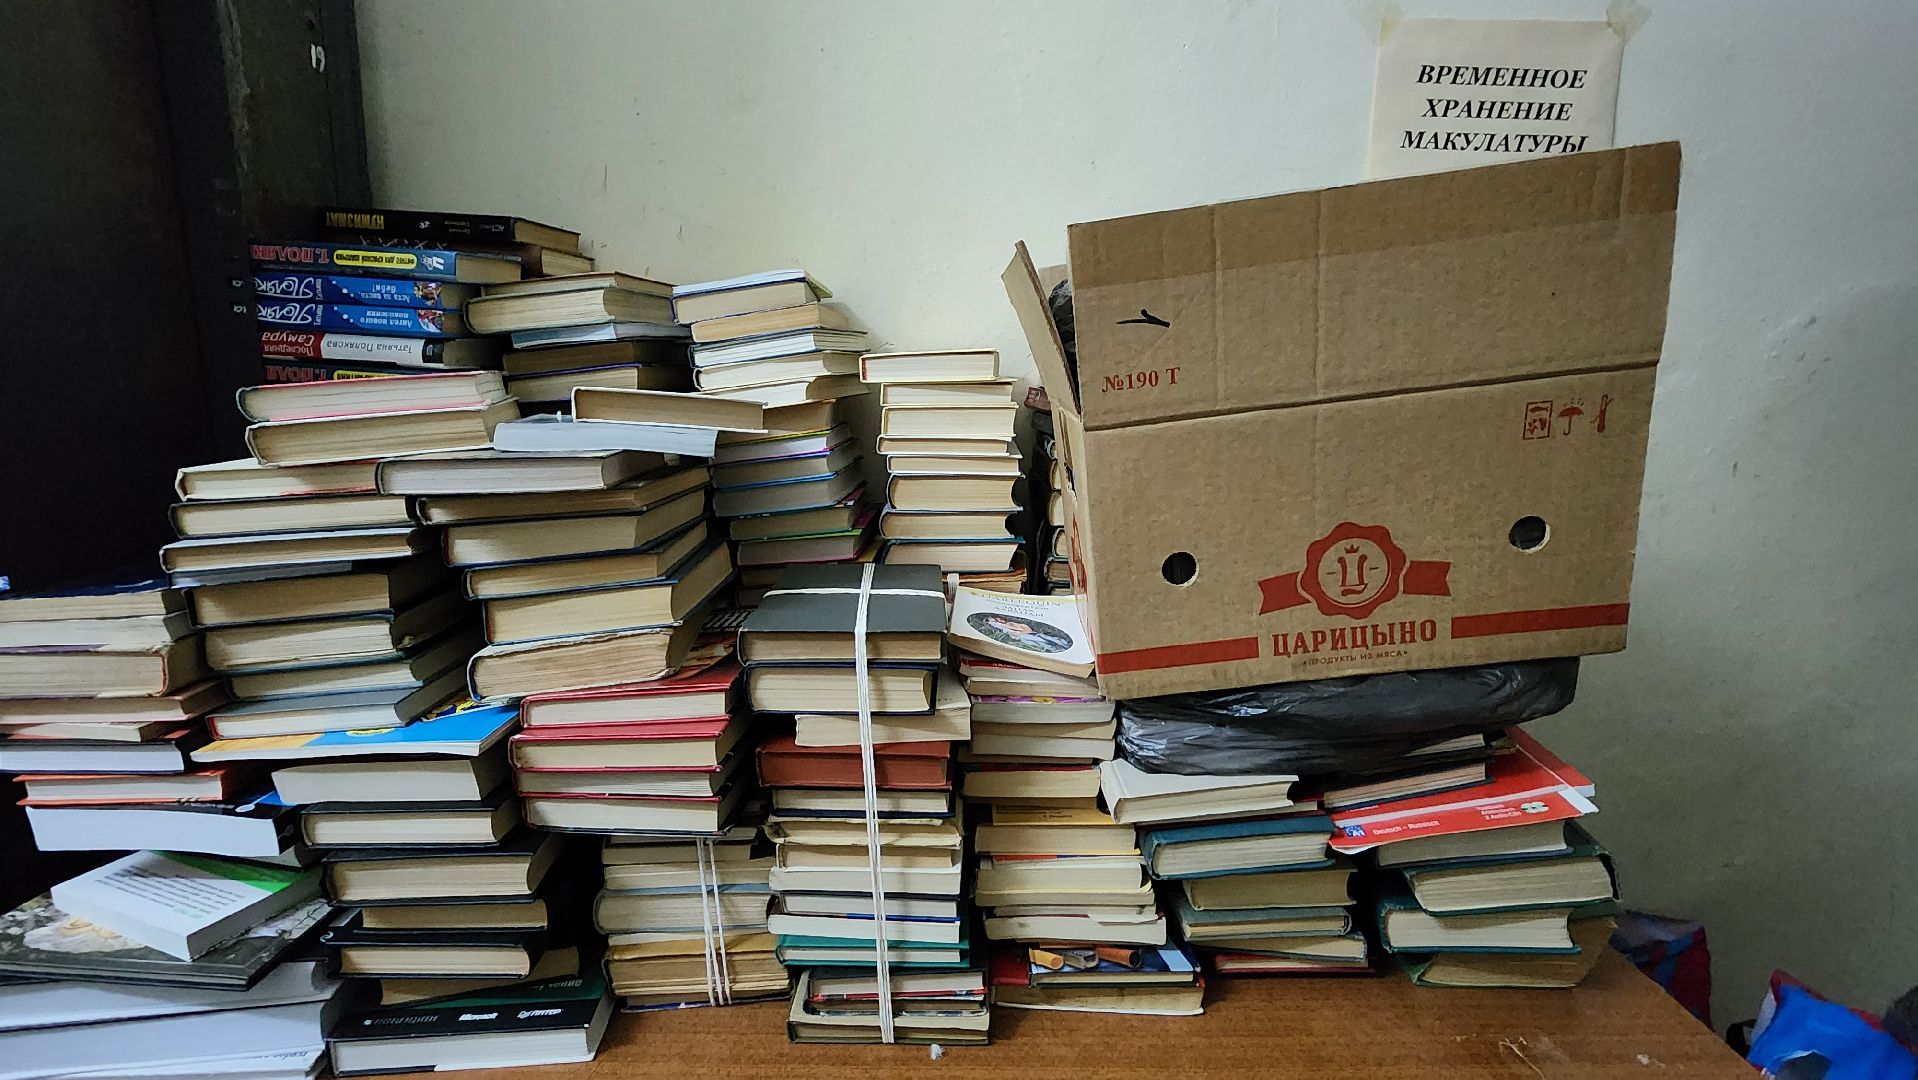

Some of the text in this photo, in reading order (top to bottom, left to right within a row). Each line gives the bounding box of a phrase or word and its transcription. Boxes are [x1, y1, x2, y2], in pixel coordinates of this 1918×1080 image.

[1416, 64, 1588, 89] ВРЕМЕННОЕ
[1420, 98, 1573, 121] ХРАНЕНИЕ
[1400, 130, 1589, 153] МАКУЛАТУРЫ
[325, 211, 385, 230] НУМИЗМАТ
[359, 316, 413, 328] Ангел нового
[263, 344, 314, 357] Последняя
[326, 340, 413, 354] Татьяна Полякова
[1101, 366, 1181, 393] №190 Т
[1271, 618, 1438, 658] ЦАРИЦЫНО
[1359, 652, 1373, 660] ИЗ
